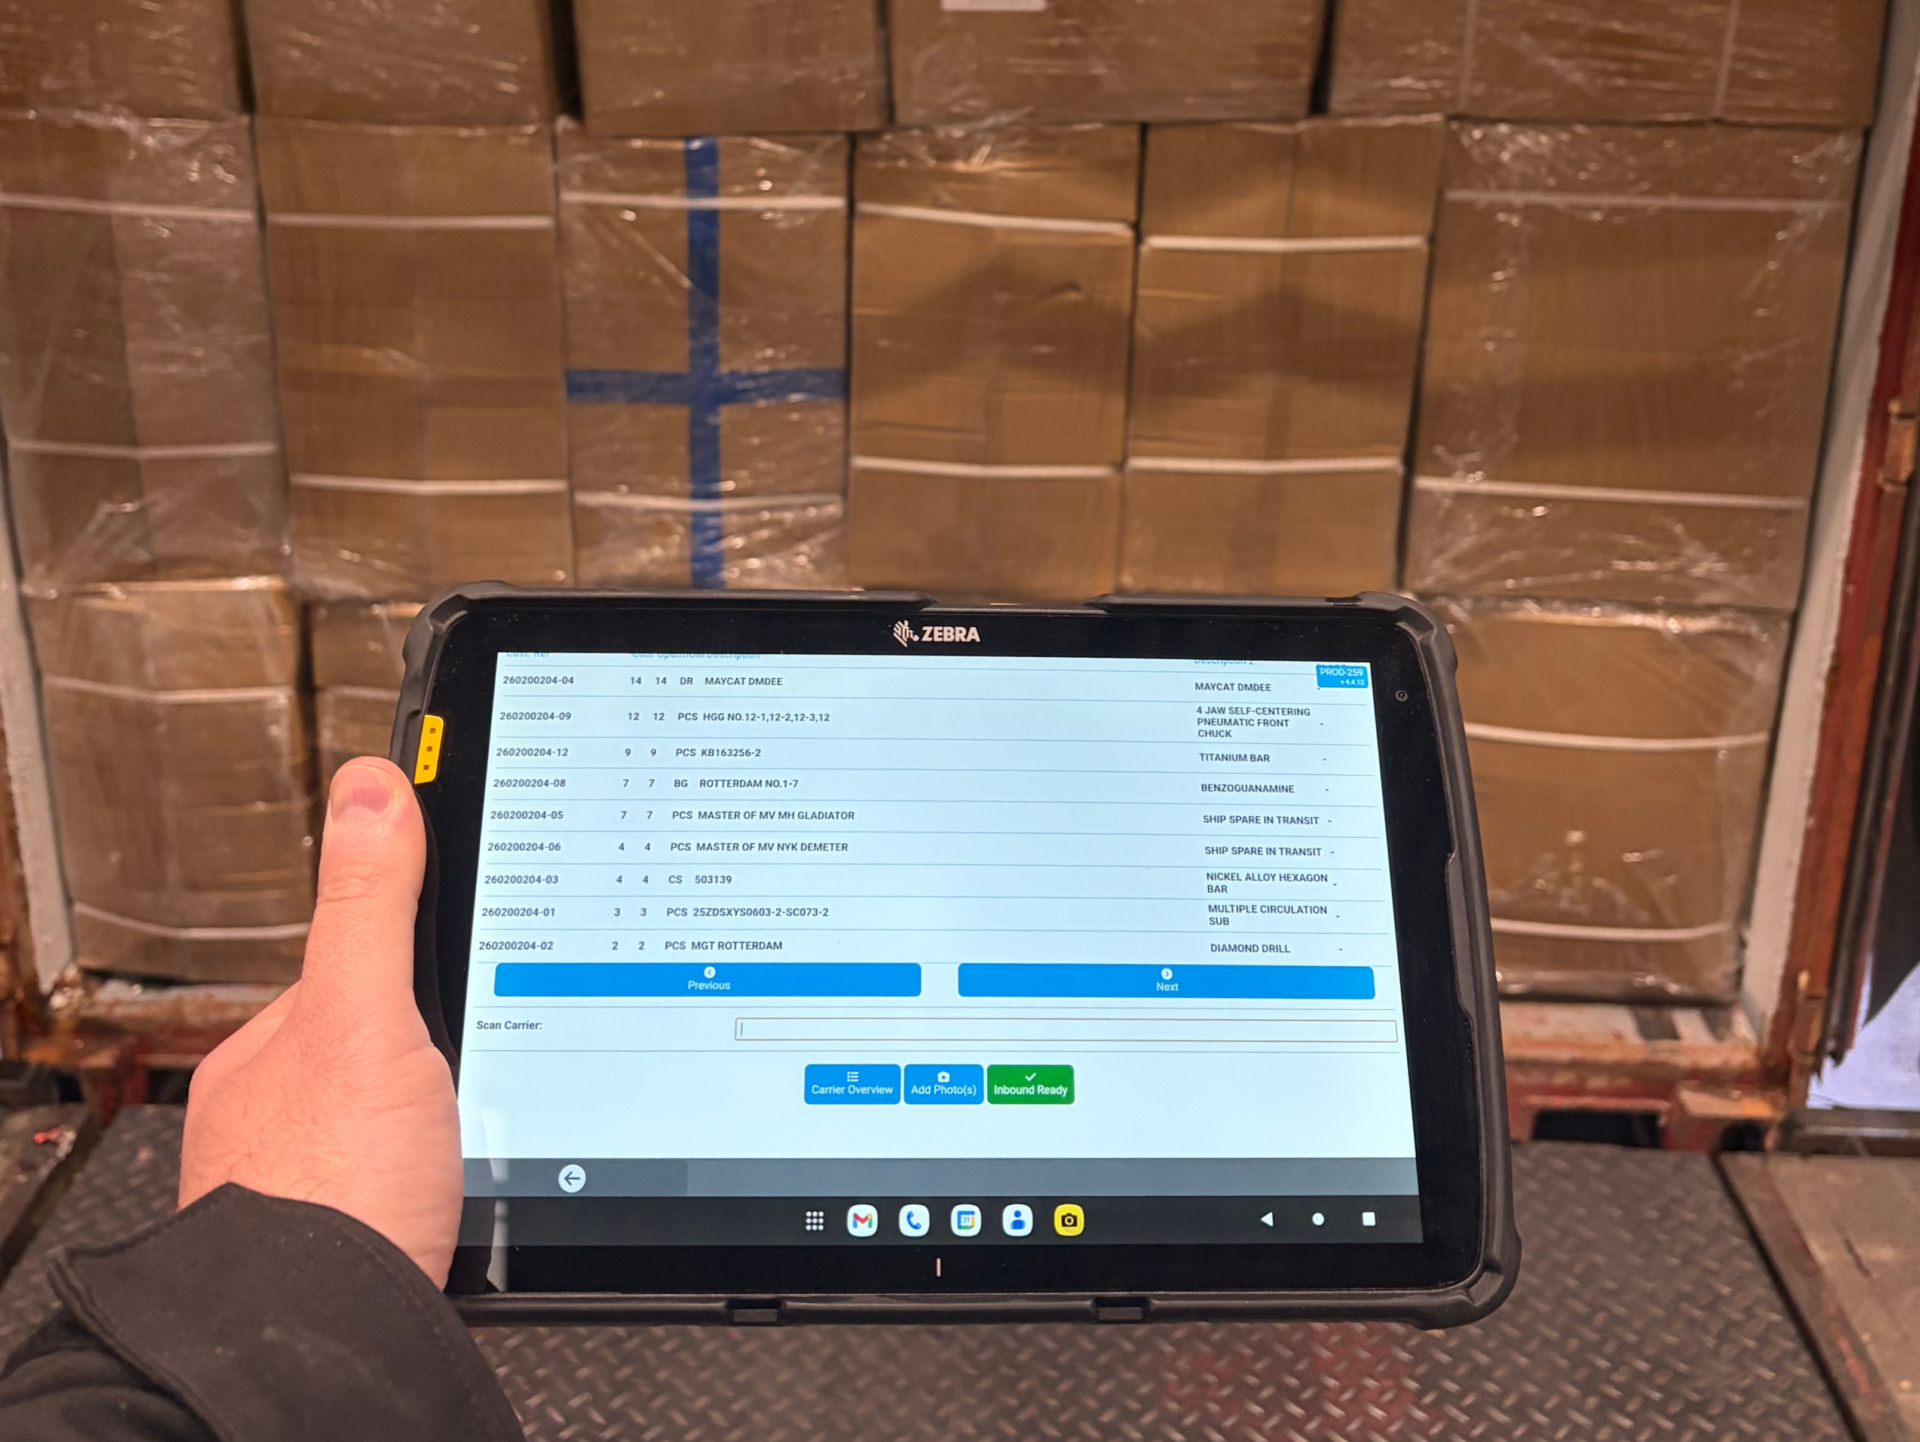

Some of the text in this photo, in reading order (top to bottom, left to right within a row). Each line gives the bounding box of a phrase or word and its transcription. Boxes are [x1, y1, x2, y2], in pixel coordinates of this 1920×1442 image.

[922, 626, 980, 643] ZEBRA
[1321, 668, 1363, 677] PROD-259
[503, 676, 783, 686] 260200204-04 14 14 DR MAYCAT DMDEE
[1195, 683, 1271, 692] MAYCAT DMDEE
[500, 712, 571, 721] 260200204-09
[628, 712, 639, 721] 12
[654, 713, 664, 721] 12
[678, 713, 698, 721] PCS
[703, 713, 724, 722] HGG
[1196, 707, 1310, 717] 4 JAW SELF-CENTERING
[1197, 718, 1289, 728] PNEUMATIC FRONT
[1198, 730, 1232, 738] CHUCK
[497, 748, 761, 758] 260200204-12 9 9 PCS KB163256-2
[1199, 753, 1269, 763] TITANIUM BAR
[494, 779, 798, 789] 260200204-08 7 7 BG ROTTERDAM NO.1-7
[1201, 784, 1294, 794] BENZOGUANAMINE
[491, 811, 854, 820] 260200204-05 7 7 PCS MASTER OF MV MH GLADIATOR
[1203, 815, 1319, 825] SHIP SPARE IN TRANSIT
[488, 842, 848, 852] 260200204-06 4 4 PCS MASTER OF MV NYK DEMETER
[1205, 847, 1321, 857] SHIP SPARE IN TRANSIT
[485, 875, 732, 885] 260200204-03 4 4 CS 503139
[1207, 872, 1327, 883] NICKEL ALLOY HEXAGON
[1207, 885, 1227, 894] BAR
[482, 908, 555, 917] 260200204-01
[613, 908, 621, 917] 3
[639, 908, 648, 917] 3
[667, 908, 687, 917] PCS
[1208, 905, 1327, 915] MULTIPLE CIRCULATION
[1209, 917, 1229, 926] SUB
[479, 941, 782, 951] 260200204-02 2 2 PCS MGT ROTTERDAM
[1211, 944, 1290, 954] DIAMOND DRILL
[688, 981, 730, 991] Previous
[1157, 982, 1178, 992] Next
[477, 1021, 542, 1030] Scan Carrier:
[812, 1085, 893, 1095] Carrier Overview
[911, 1085, 976, 1097] Add Photo(s)
[994, 1085, 1068, 1098] Inbound Ready
